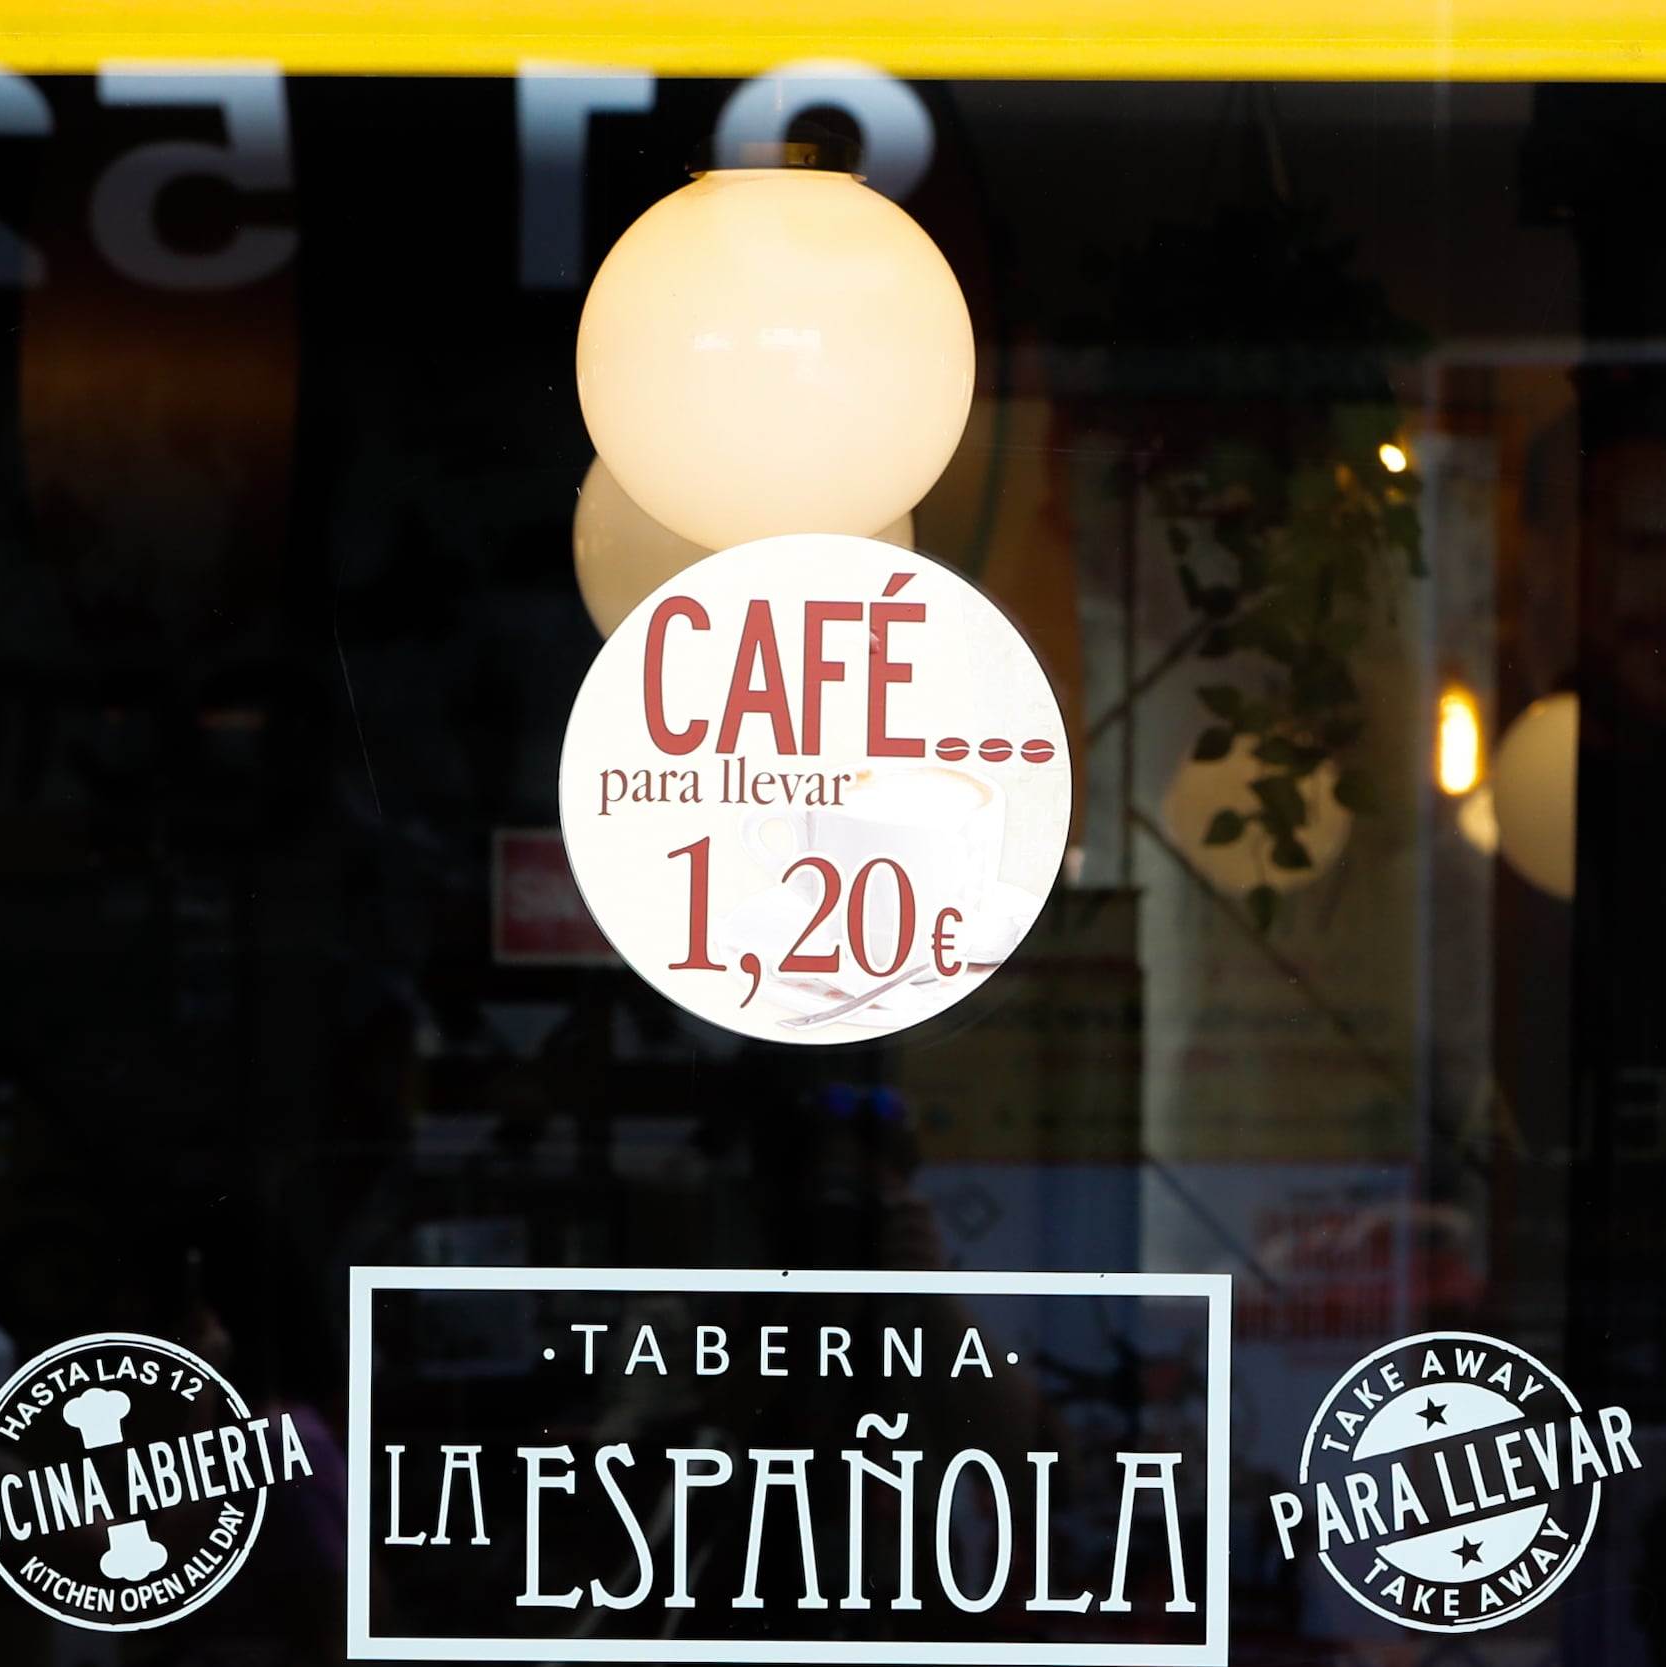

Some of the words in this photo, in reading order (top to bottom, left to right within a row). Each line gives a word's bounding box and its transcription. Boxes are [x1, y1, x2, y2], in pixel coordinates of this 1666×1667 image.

[598, 766, 703, 815] para
[719, 757, 850, 806] llevar
[0, 1362, 89, 1441] HASTA
[96, 1355, 161, 1384] LAS
[170, 1369, 203, 1401] 12
[1321, 1362, 1405, 1454] TAKE
[1421, 1347, 1544, 1404] AWAY
[127, 1412, 313, 1515] ABIERTA
[383, 1444, 491, 1547] LA
[515, 1411, 1197, 1614] ESPAÑOLA
[1269, 1461, 1430, 1560] PARA
[1434, 1405, 1643, 1518] LLEVAR
[20, 1556, 115, 1613] KITCHEN
[120, 1572, 185, 1613] OPEN
[188, 1548, 223, 1588] ALL
[208, 1501, 245, 1549] DAY
[1363, 1557, 1460, 1617] TAKE
[1480, 1517, 1570, 1612] AWAY
